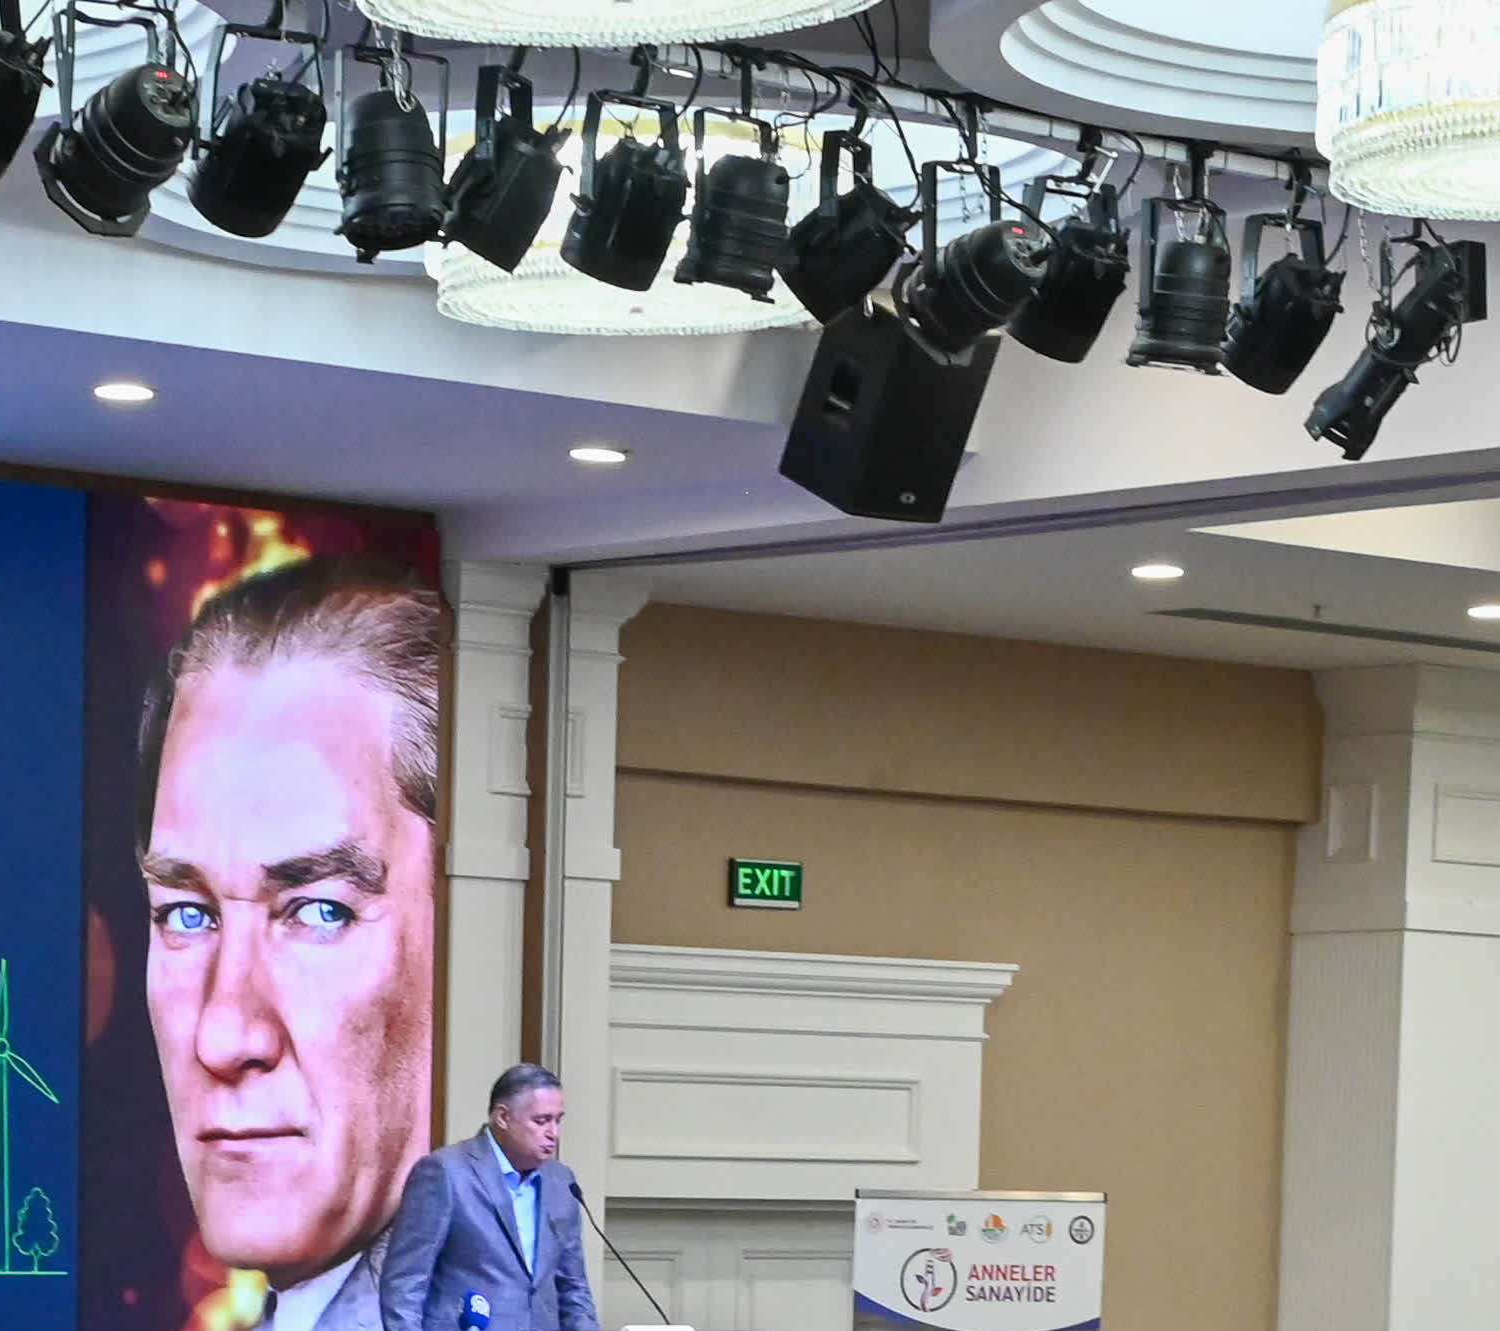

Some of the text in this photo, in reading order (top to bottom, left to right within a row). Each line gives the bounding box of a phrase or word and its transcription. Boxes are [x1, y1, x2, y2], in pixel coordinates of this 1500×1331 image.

[738, 867, 796, 896] EXIT
[968, 1264, 1055, 1282] ANNELER
[966, 1283, 1056, 1303] SANAYİDE
